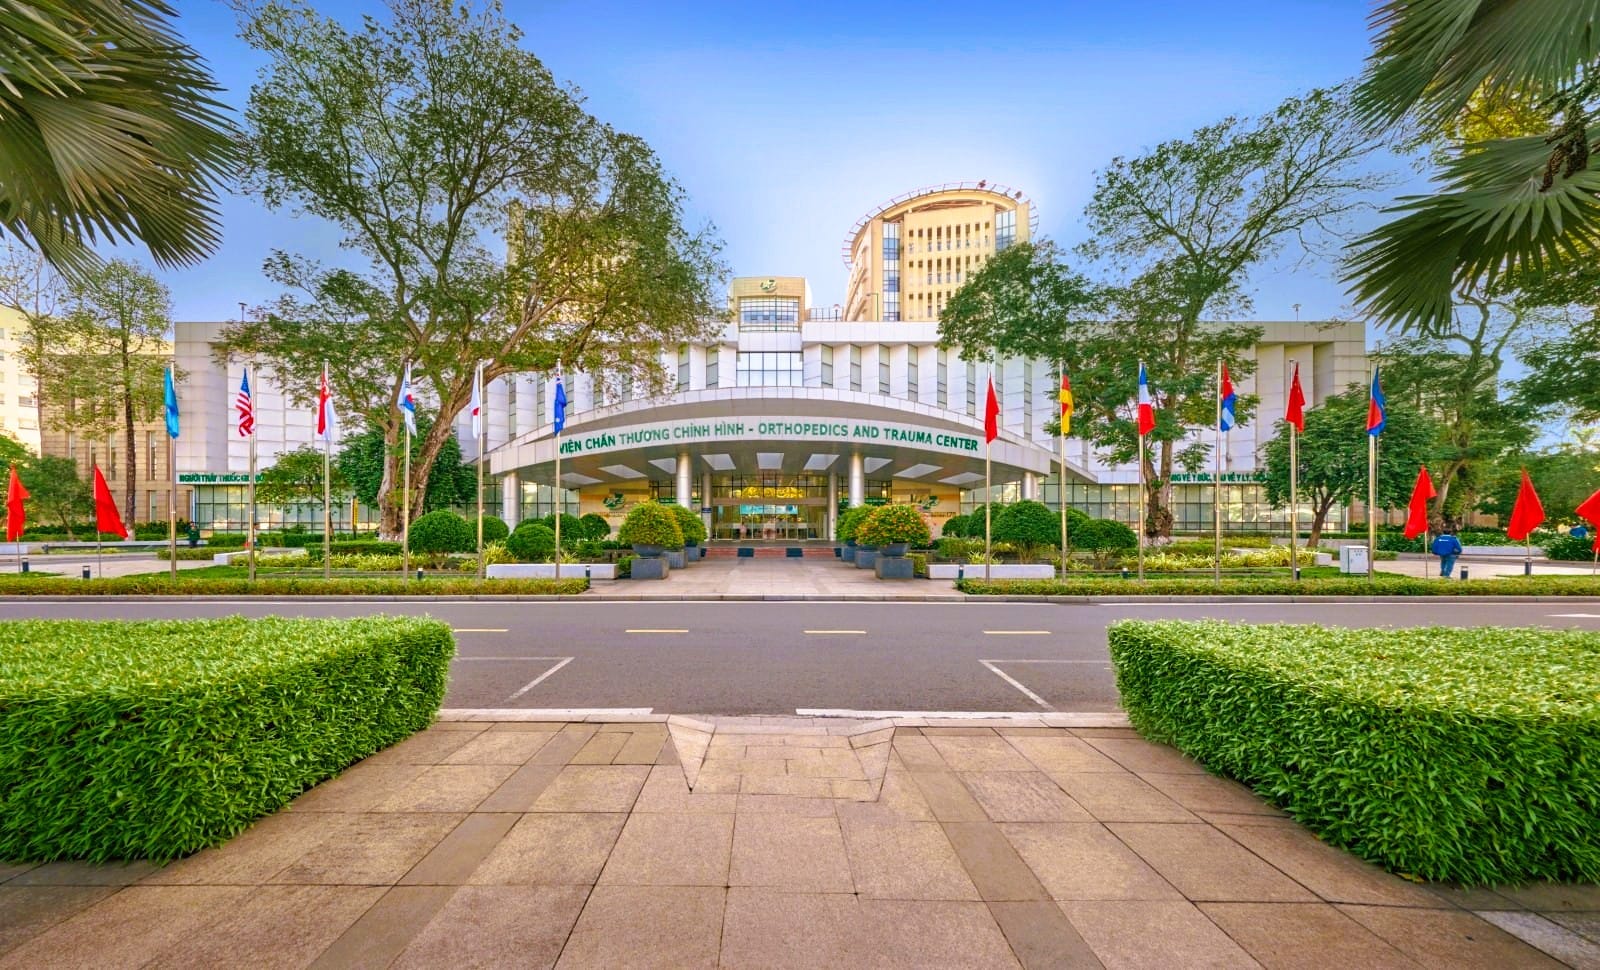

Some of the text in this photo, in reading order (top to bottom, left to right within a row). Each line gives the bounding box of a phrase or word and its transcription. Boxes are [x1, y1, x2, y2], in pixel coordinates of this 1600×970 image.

[585, 432, 616, 450] CHẤN
[619, 428, 670, 444] THƯƠNG
[673, 423, 710, 438] CHỈNH
[714, 421, 744, 436] HÌNH
[758, 422, 849, 437] ORTHOPEDICS
[853, 425, 880, 438] AND
[883, 428, 933, 445] TRAUMA
[936, 434, 978, 451] CENTER
